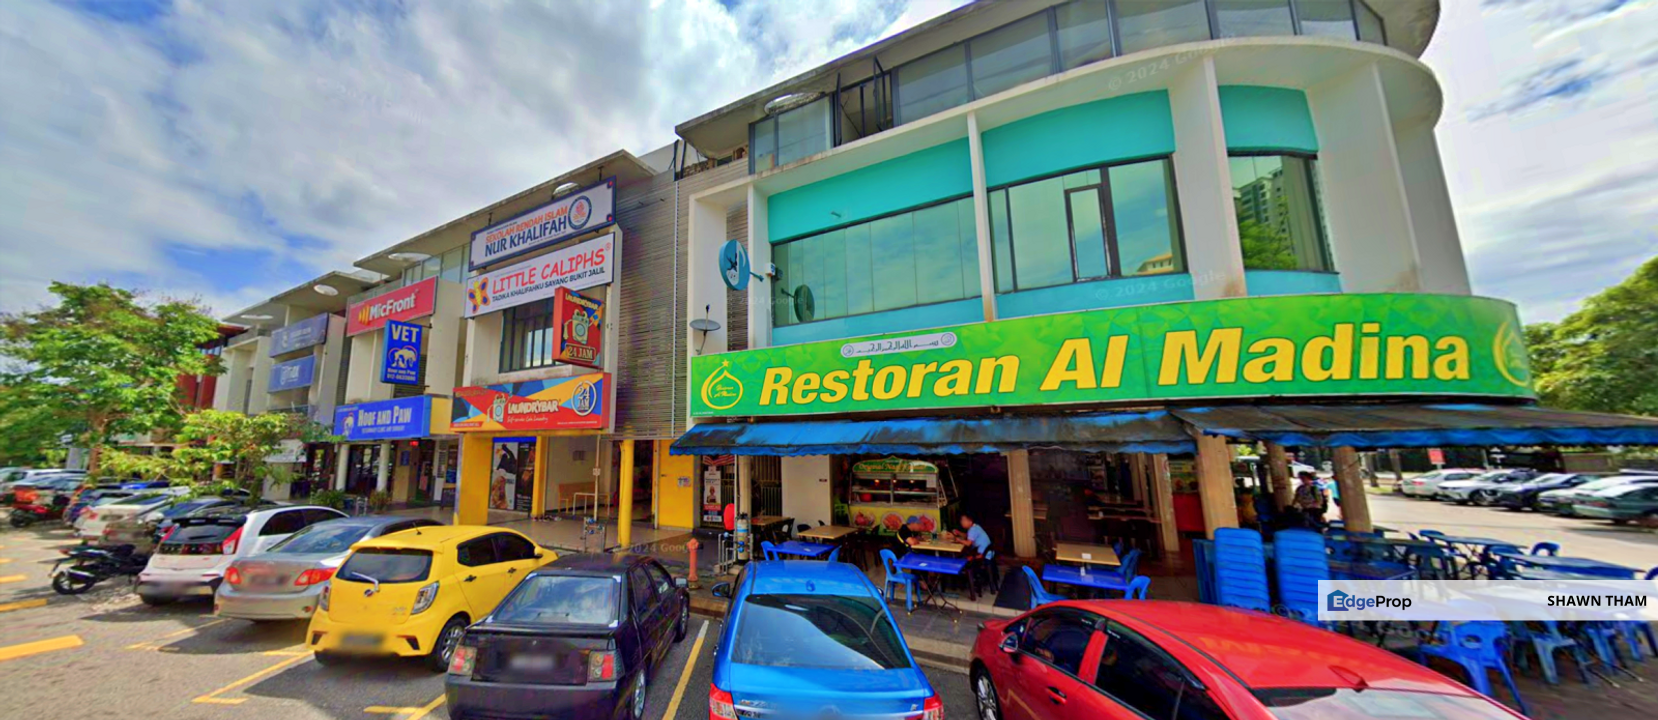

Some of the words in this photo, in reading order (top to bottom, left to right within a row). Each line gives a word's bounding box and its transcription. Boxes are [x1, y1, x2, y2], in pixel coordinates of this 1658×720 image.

[485, 223, 516, 243] SEKOLAH
[516, 215, 544, 233] RENDAH
[544, 206, 568, 223] ISLAM
[485, 242, 507, 257] NUR
[509, 216, 567, 248] KHALIFAH
[492, 268, 537, 294] LITTLE
[541, 248, 606, 280] CALIPHS
[492, 292, 510, 302] TADIKA
[544, 276, 568, 289] SAYANG
[569, 271, 587, 283] BUKIT
[588, 267, 605, 278] JALIL
[370, 293, 415, 320] MicFront
[391, 323, 420, 343] VET
[568, 346, 577, 357] 24
[578, 348, 593, 360] JAM
[758, 353, 1020, 406] Restoran
[1040, 333, 1129, 390] Al
[1158, 323, 1470, 385] Madina
[577, 397, 590, 408] JAM
[578, 386, 590, 400] 24
[507, 399, 559, 415] LAUNDRYBAR
